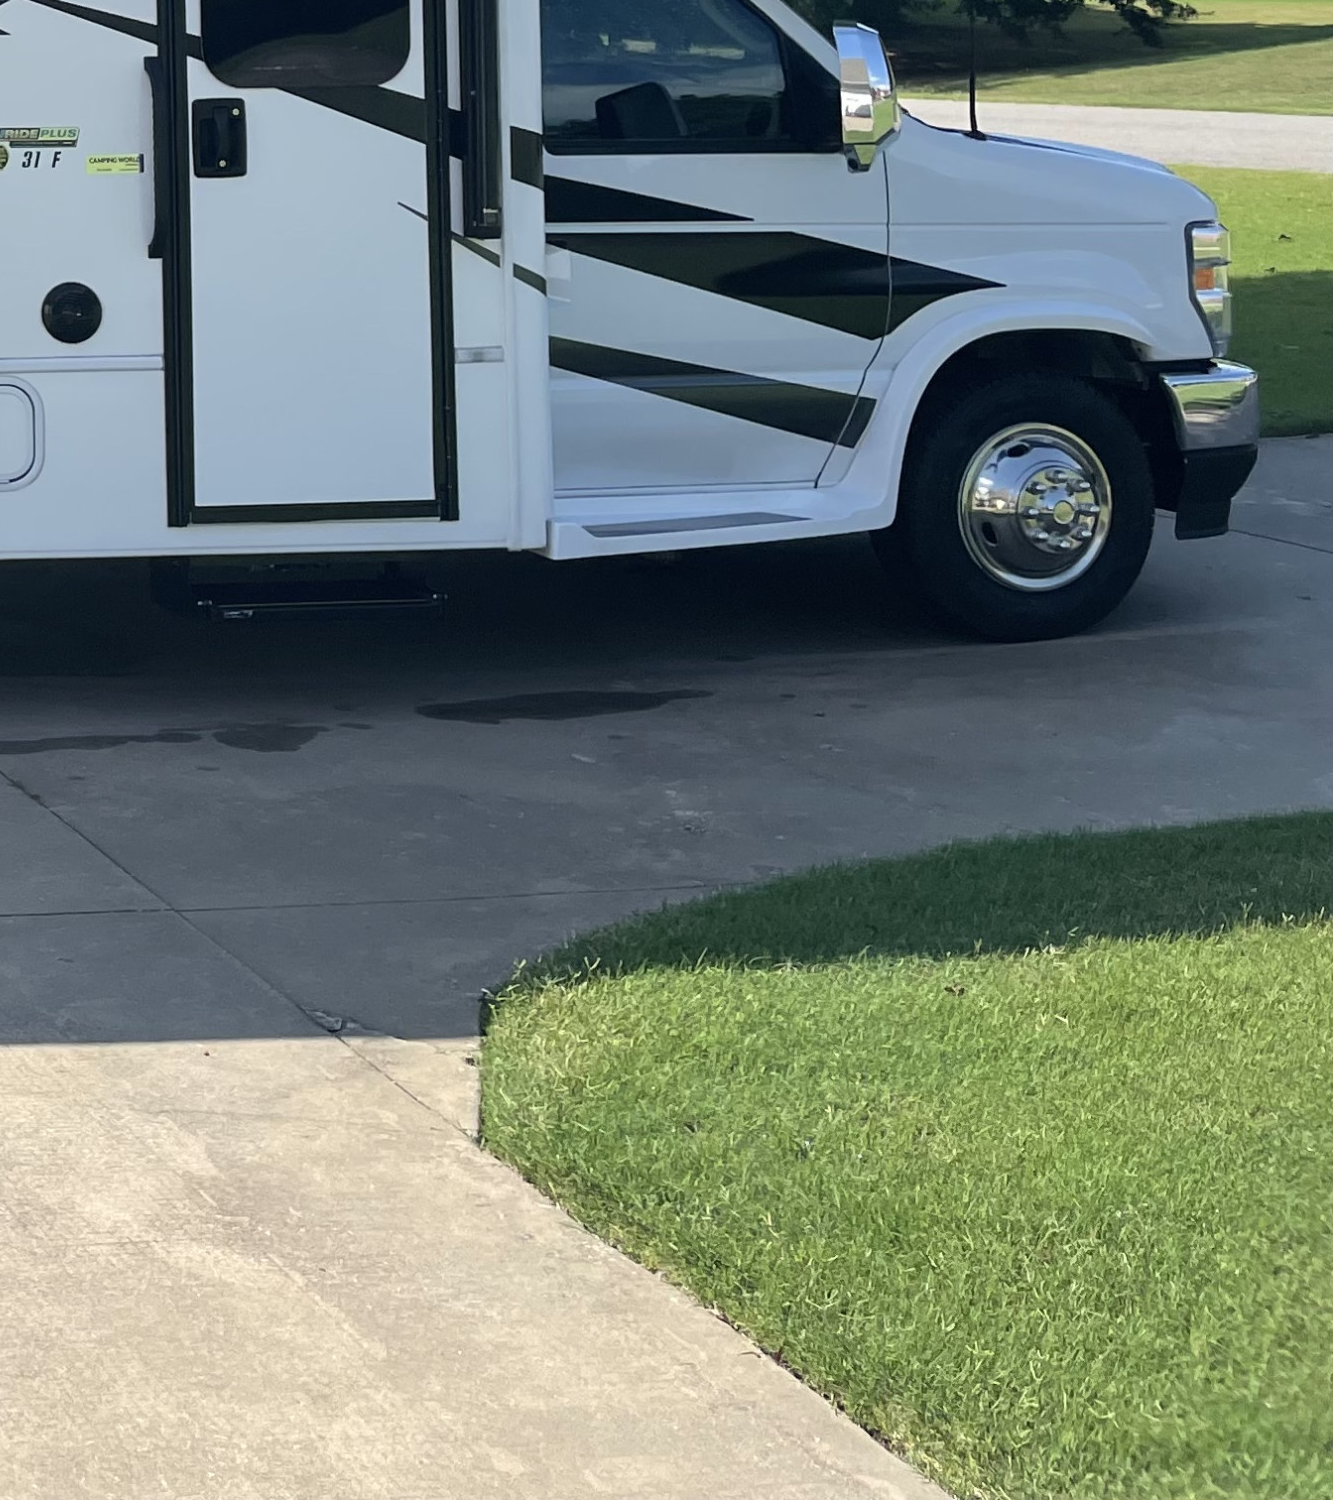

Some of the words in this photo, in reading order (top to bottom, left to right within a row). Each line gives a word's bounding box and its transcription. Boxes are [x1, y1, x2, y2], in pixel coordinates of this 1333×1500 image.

[40, 128, 77, 138] PLUS
[21, 151, 41, 168] 31
[51, 151, 62, 168] F
